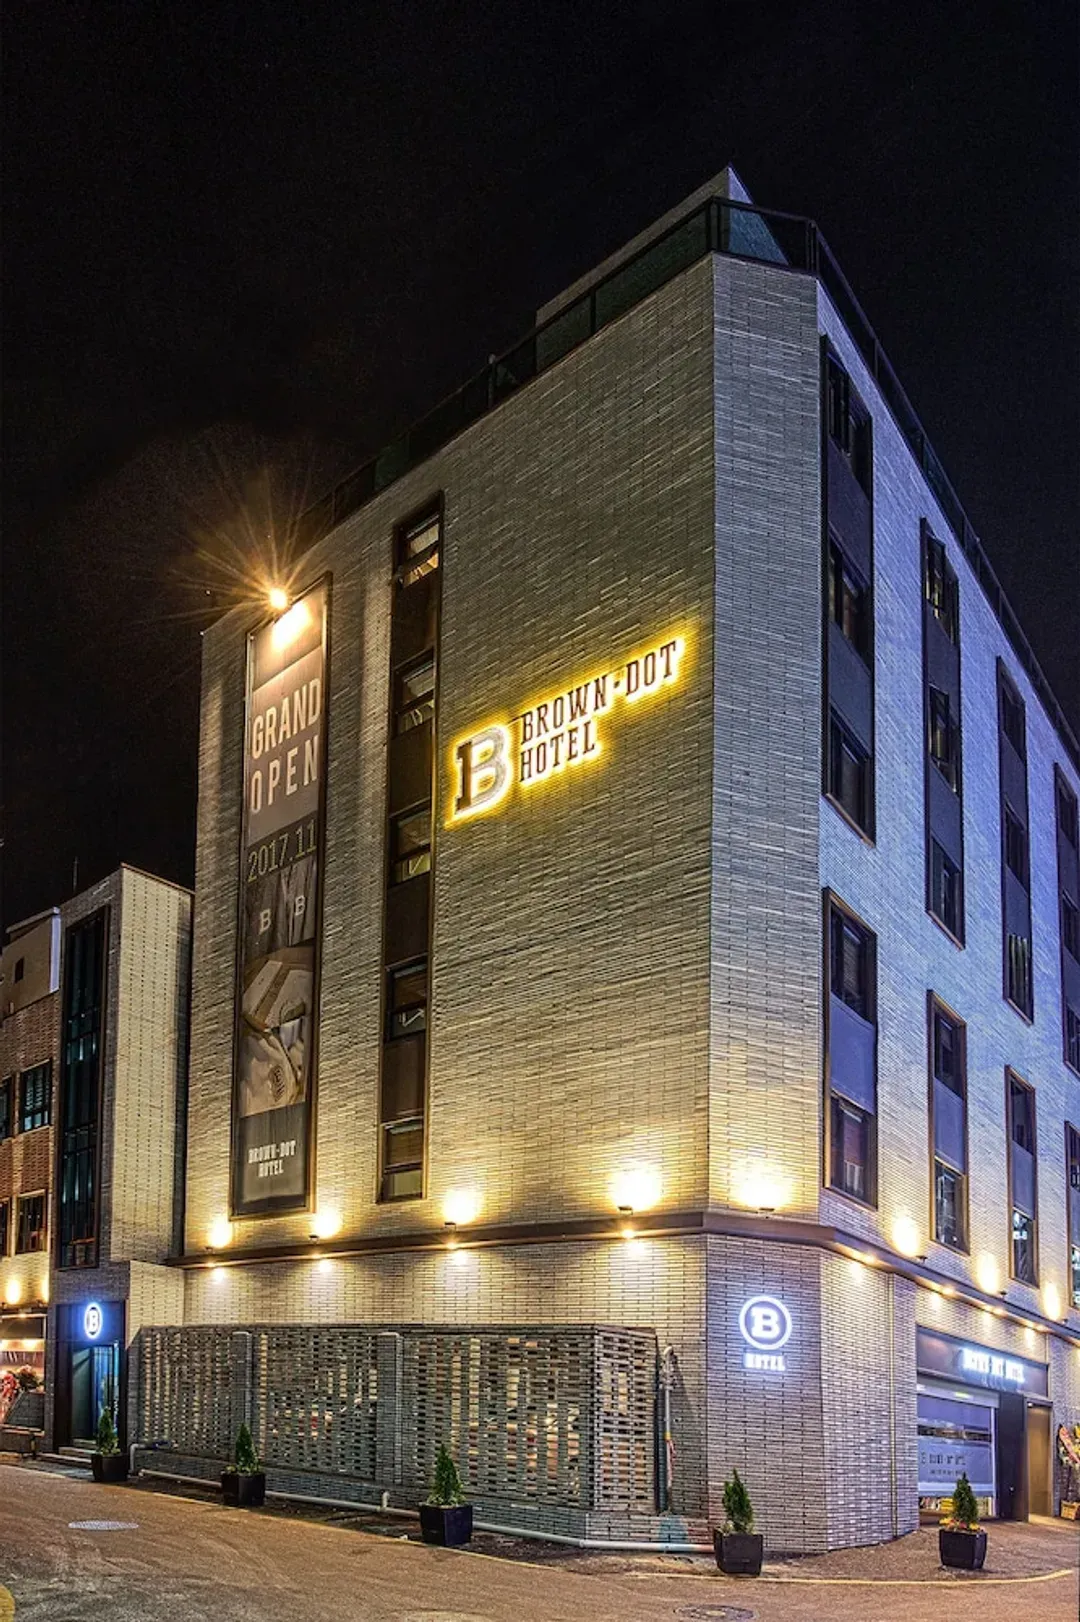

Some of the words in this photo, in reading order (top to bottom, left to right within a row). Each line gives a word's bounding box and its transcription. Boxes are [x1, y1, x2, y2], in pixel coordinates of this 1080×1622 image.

[251, 677, 321, 760] GRAND
[250, 734, 320, 814] OPEN
[454, 726, 508, 813] B
[520, 720, 596, 782] HOTEL
[247, 818, 317, 882] 2017.11
[259, 908, 272, 934] B
[293, 895, 306, 916] B
